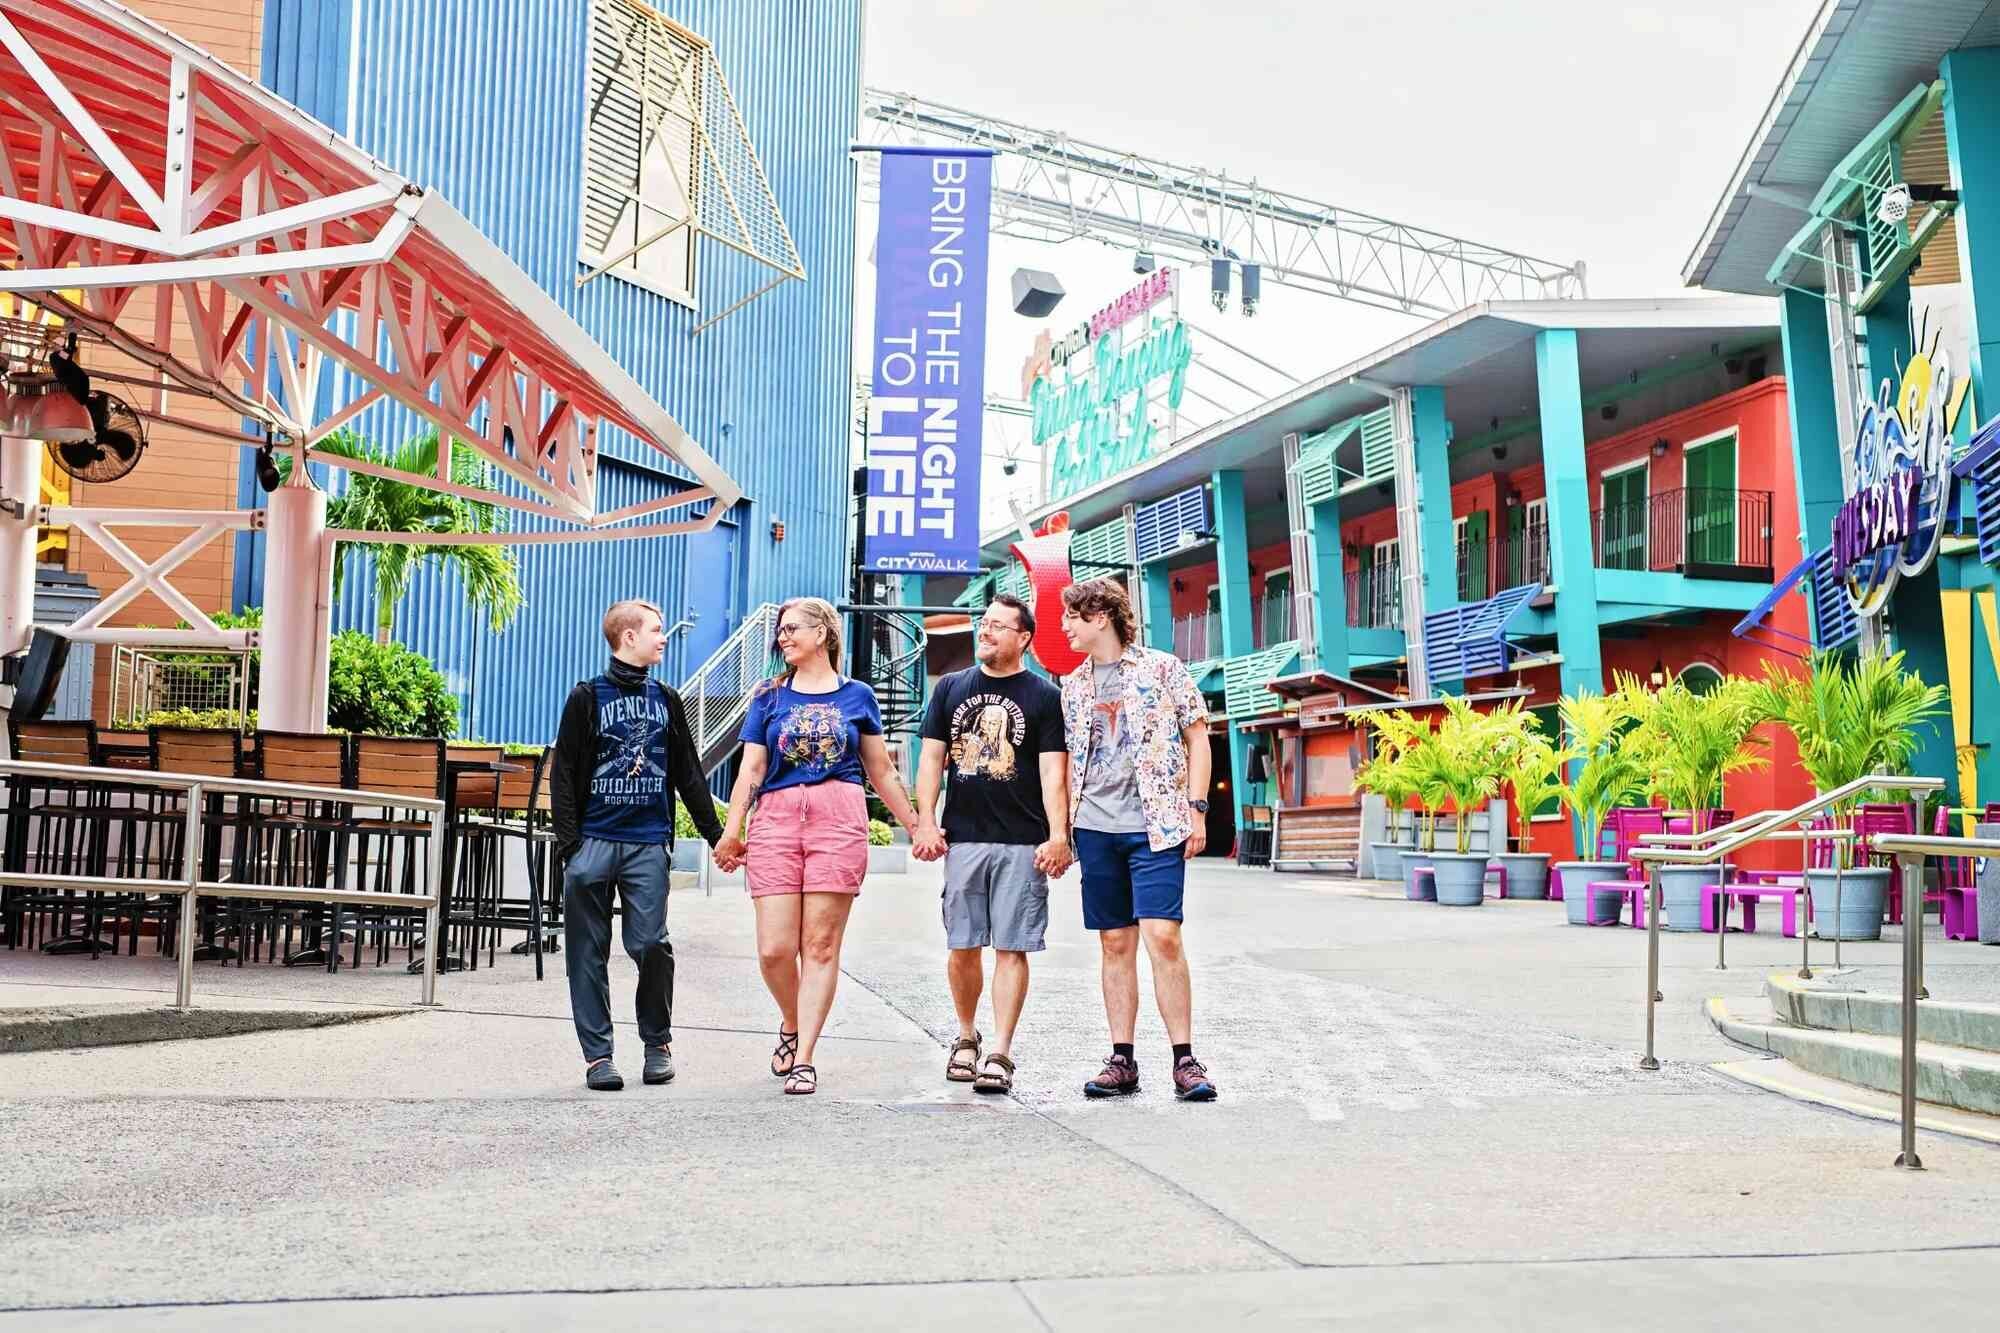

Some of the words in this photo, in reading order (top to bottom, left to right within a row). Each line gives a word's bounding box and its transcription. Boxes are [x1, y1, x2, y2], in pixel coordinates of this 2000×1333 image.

[928, 158, 967, 288] BRING
[881, 327, 918, 386] TO
[924, 301, 962, 384] THE
[864, 396, 918, 536] LIFE
[919, 397, 958, 539] NIGHT
[876, 557, 968, 570] CITYWALK
[597, 695, 669, 734] AVENCLAW
[952, 703, 968, 724] HERE
[966, 695, 983, 708] FOR
[984, 694, 1003, 704] THE
[1001, 698, 1026, 746] BUTTERBEER
[591, 777, 664, 795] QUIDDITCH
[604, 796, 649, 806] HOGWARTS
